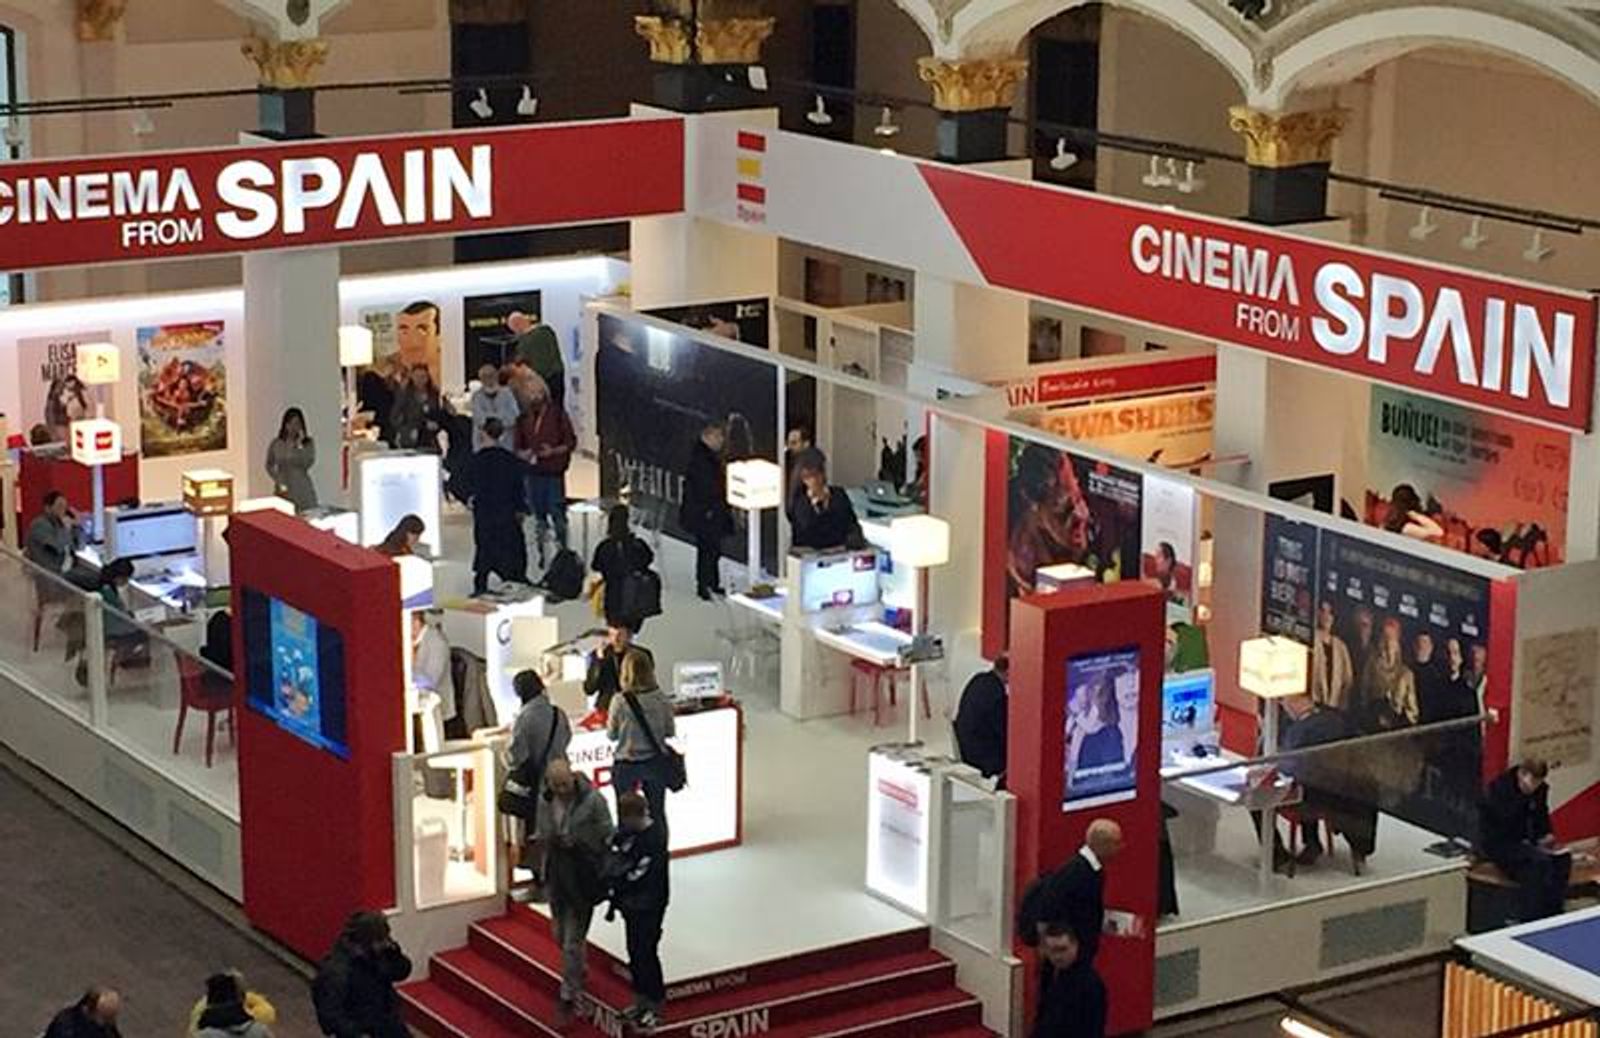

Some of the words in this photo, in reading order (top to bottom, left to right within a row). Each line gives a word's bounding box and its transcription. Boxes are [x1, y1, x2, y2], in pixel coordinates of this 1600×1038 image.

[215, 144, 493, 240] SPAIN
[121, 218, 203, 247] FROM
[1130, 223, 1300, 306] CINEMA
[1235, 302, 1301, 342] FROM
[1311, 261, 1576, 409] SPAIN
[690, 1007, 769, 1038] SPAIN
